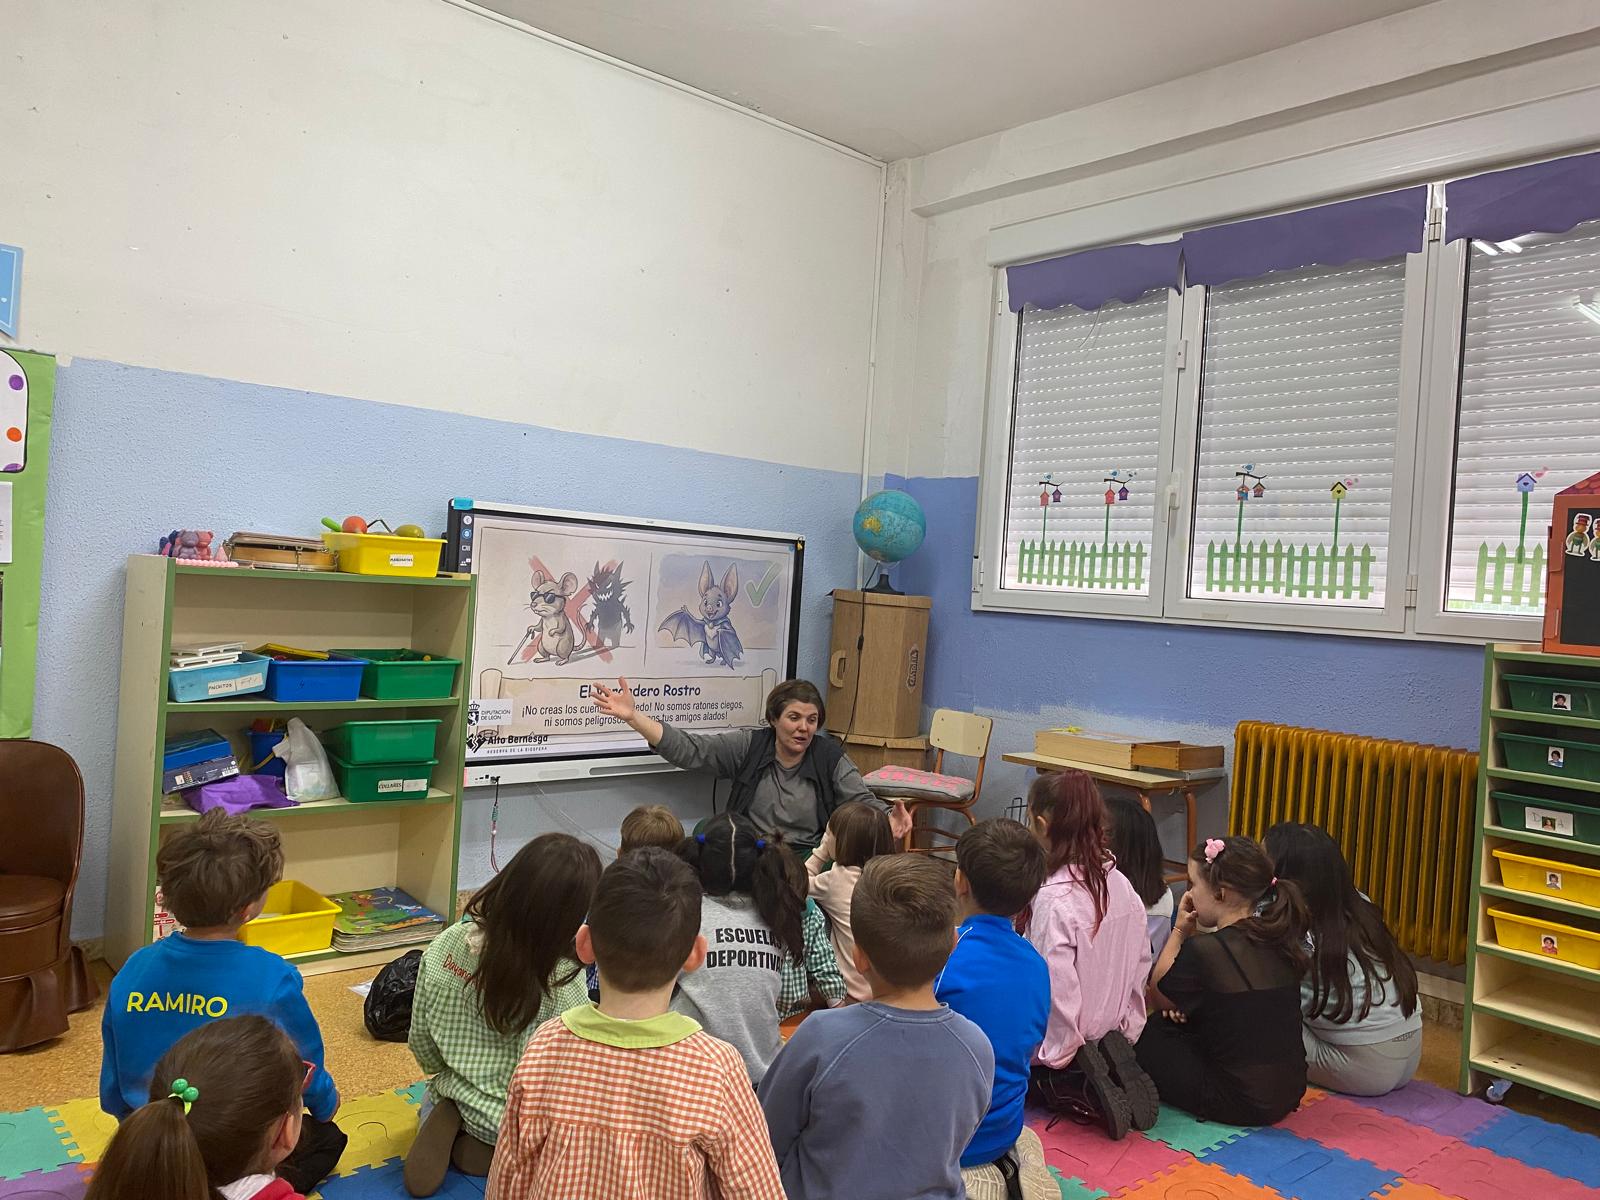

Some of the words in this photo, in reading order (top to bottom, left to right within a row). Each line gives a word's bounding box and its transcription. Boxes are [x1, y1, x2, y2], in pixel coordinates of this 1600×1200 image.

[579, 685, 591, 698] El
[664, 684, 700, 697] Rostro
[540, 706, 563, 715] creas
[565, 704, 578, 714] los
[654, 702, 665, 711] No
[666, 702, 691, 711] somos
[692, 701, 719, 710] ratones
[720, 700, 744, 711] ciegos,
[544, 717, 552, 726] ni
[555, 716, 582, 726] somos
[662, 713, 674, 721] tus
[675, 712, 701, 723] amigos
[702, 711, 728, 721] alados!
[487, 736, 506, 744] Alto
[715, 928, 781, 949] ESCUELA
[127, 991, 228, 1017] RAMIRO
